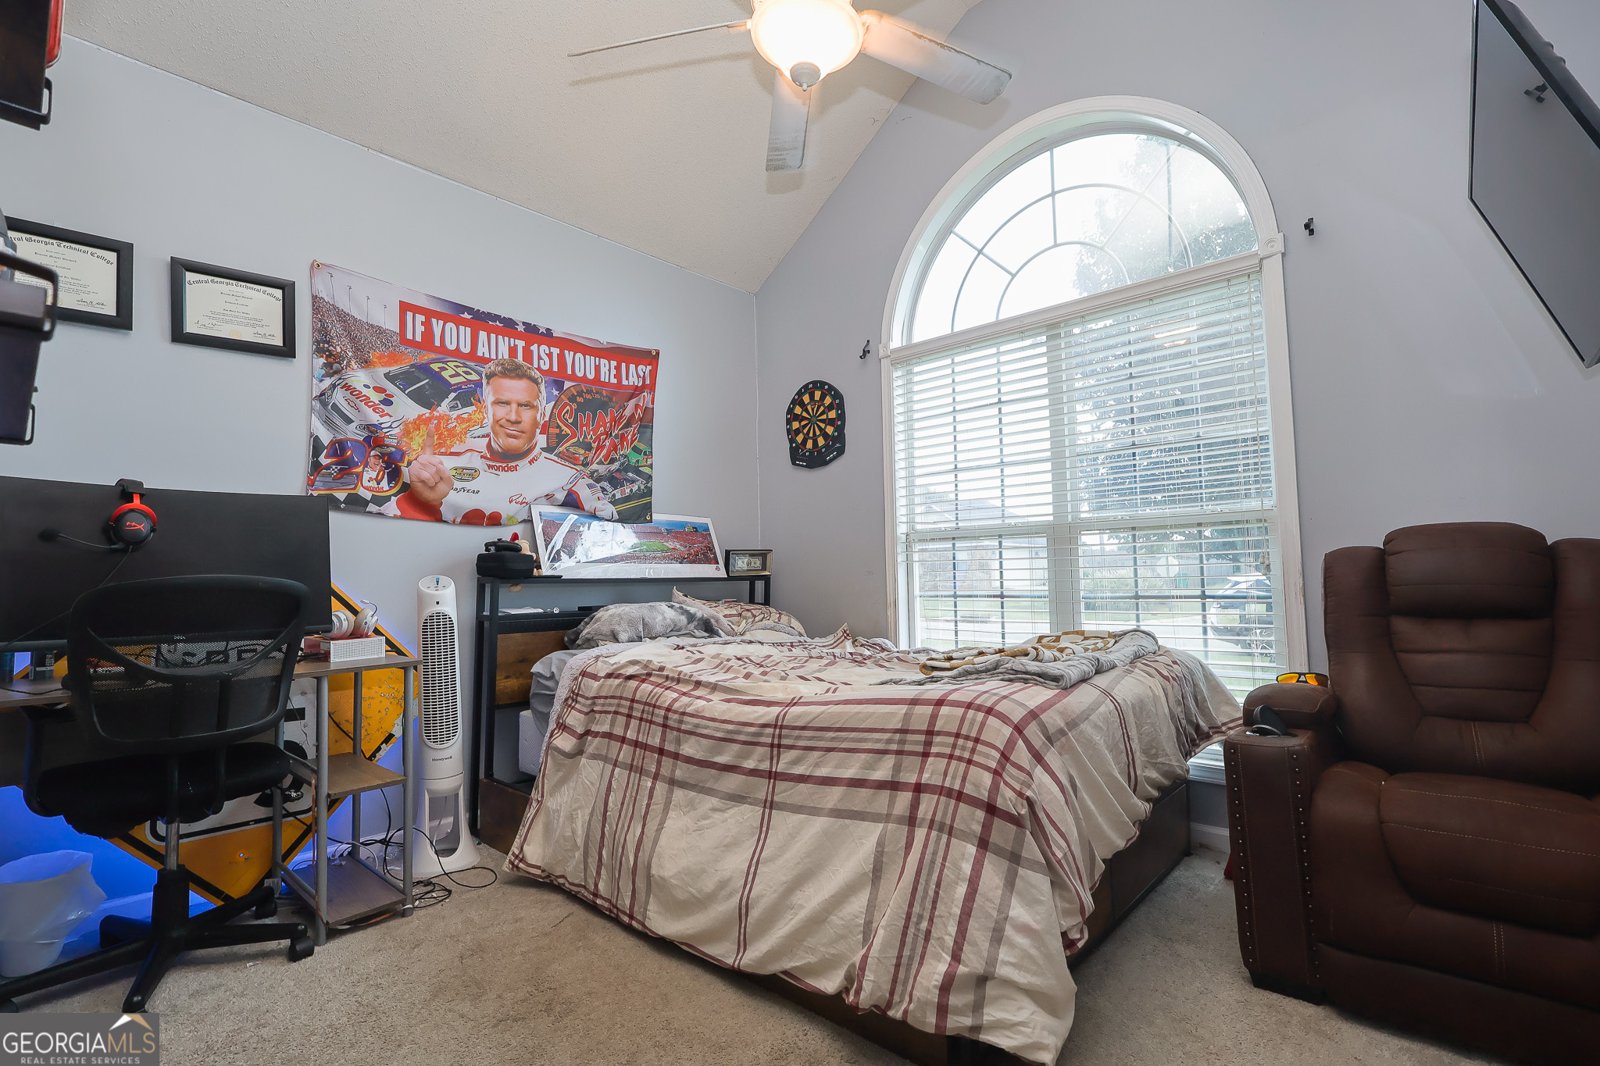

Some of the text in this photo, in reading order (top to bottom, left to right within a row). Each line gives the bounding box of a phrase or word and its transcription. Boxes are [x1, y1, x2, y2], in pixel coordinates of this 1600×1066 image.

[25, 236, 54, 246] Georgia
[55, 241, 89, 255] Technical
[90, 251, 114, 266] College
[187, 278, 209, 286] Central
[210, 278, 234, 288] Georgia
[235, 281, 261, 294] Technical
[262, 289, 282, 303] College
[406, 311, 652, 387] IF YOU AIN'T 1ST YOU'RE LAST
[429, 361, 481, 385] 26
[340, 381, 393, 419] wonder
[307, 437, 408, 496] 26
[485, 462, 520, 473] wonder
